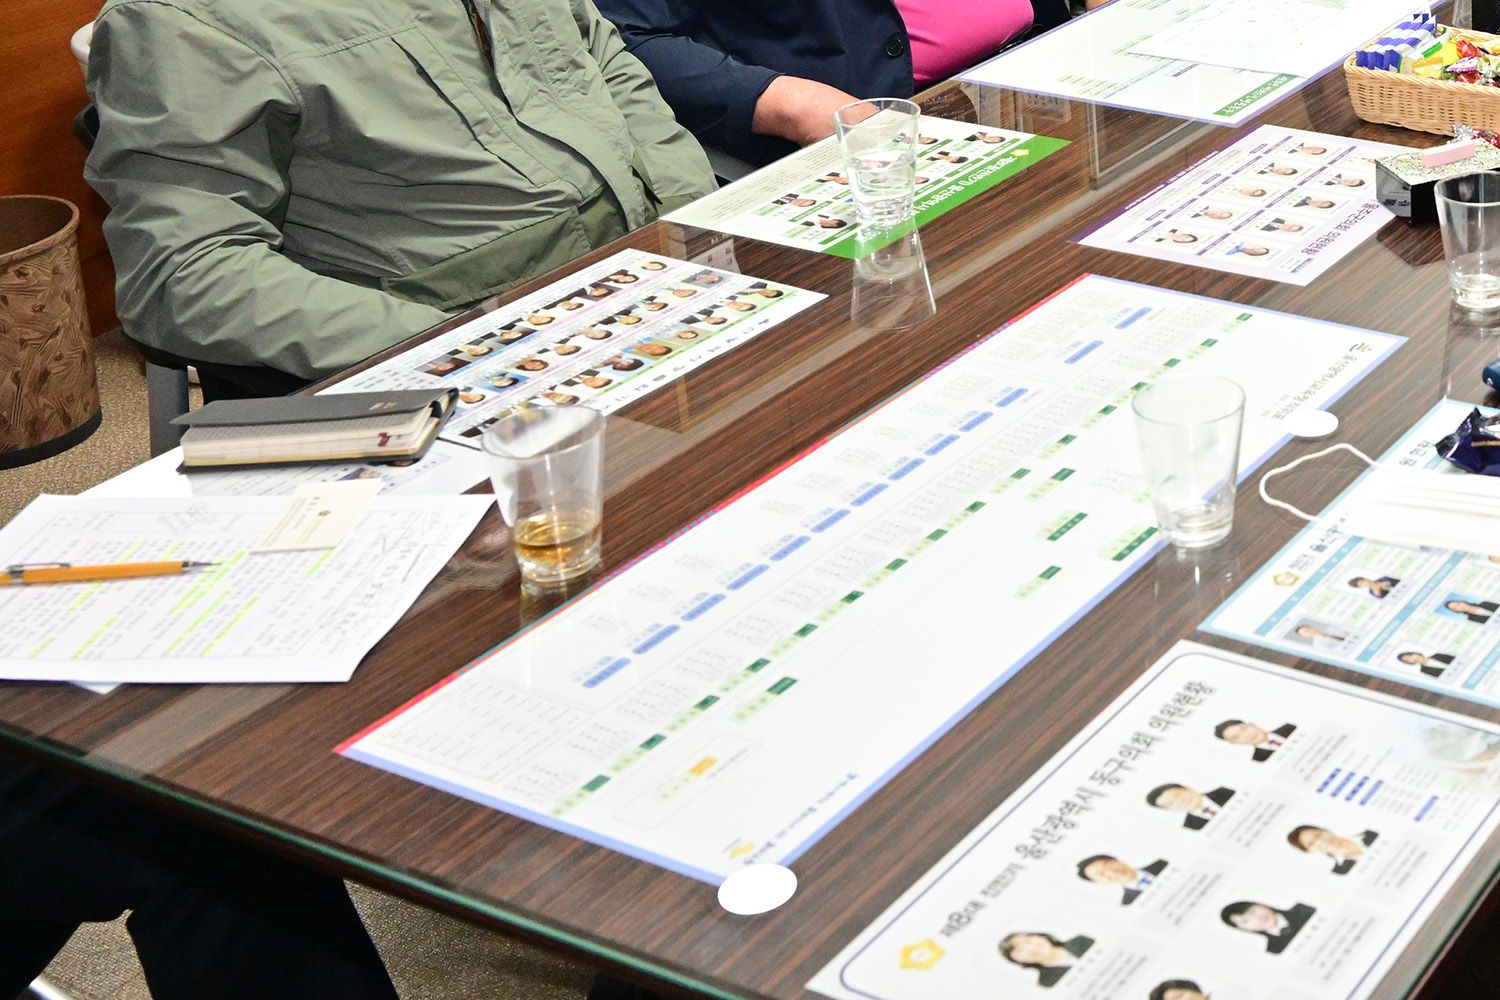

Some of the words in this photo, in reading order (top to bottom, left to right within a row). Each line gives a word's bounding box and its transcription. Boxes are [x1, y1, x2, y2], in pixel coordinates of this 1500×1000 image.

[1333, 202, 1380, 232] 울주군의회
[1300, 231, 1341, 256] 의원현황
[939, 898, 988, 938] 제8대
[1014, 785, 1111, 860] 울산광역시
[1089, 730, 1166, 787] 동구의회
[1148, 680, 1218, 732] 의원현황
